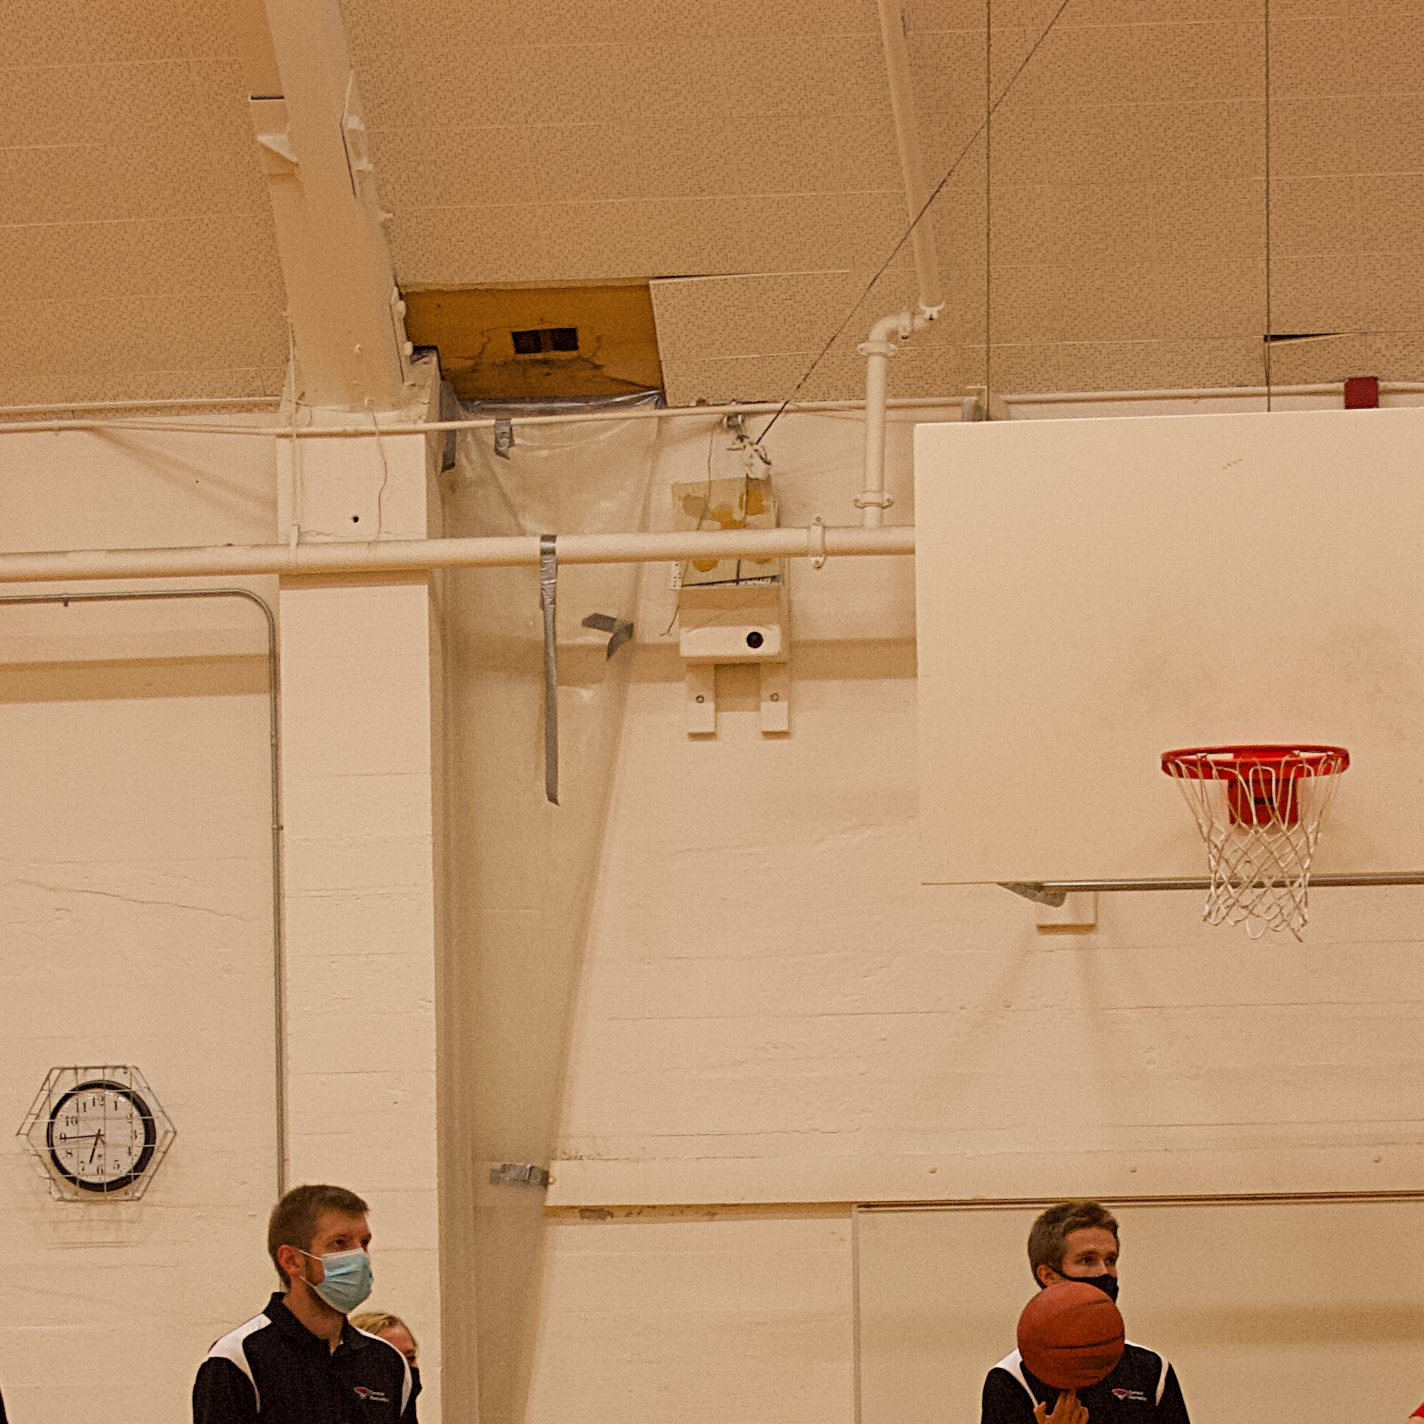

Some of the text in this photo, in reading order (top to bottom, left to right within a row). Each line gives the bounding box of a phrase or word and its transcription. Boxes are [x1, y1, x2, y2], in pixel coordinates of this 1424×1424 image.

[92, 1096, 105, 1107] 12
[113, 1100, 118, 1111] 1
[65, 1115, 78, 1127] 10
[79, 1160, 86, 1172] 7
[96, 1164, 104, 1175] 6
[112, 1159, 120, 1170] 5
